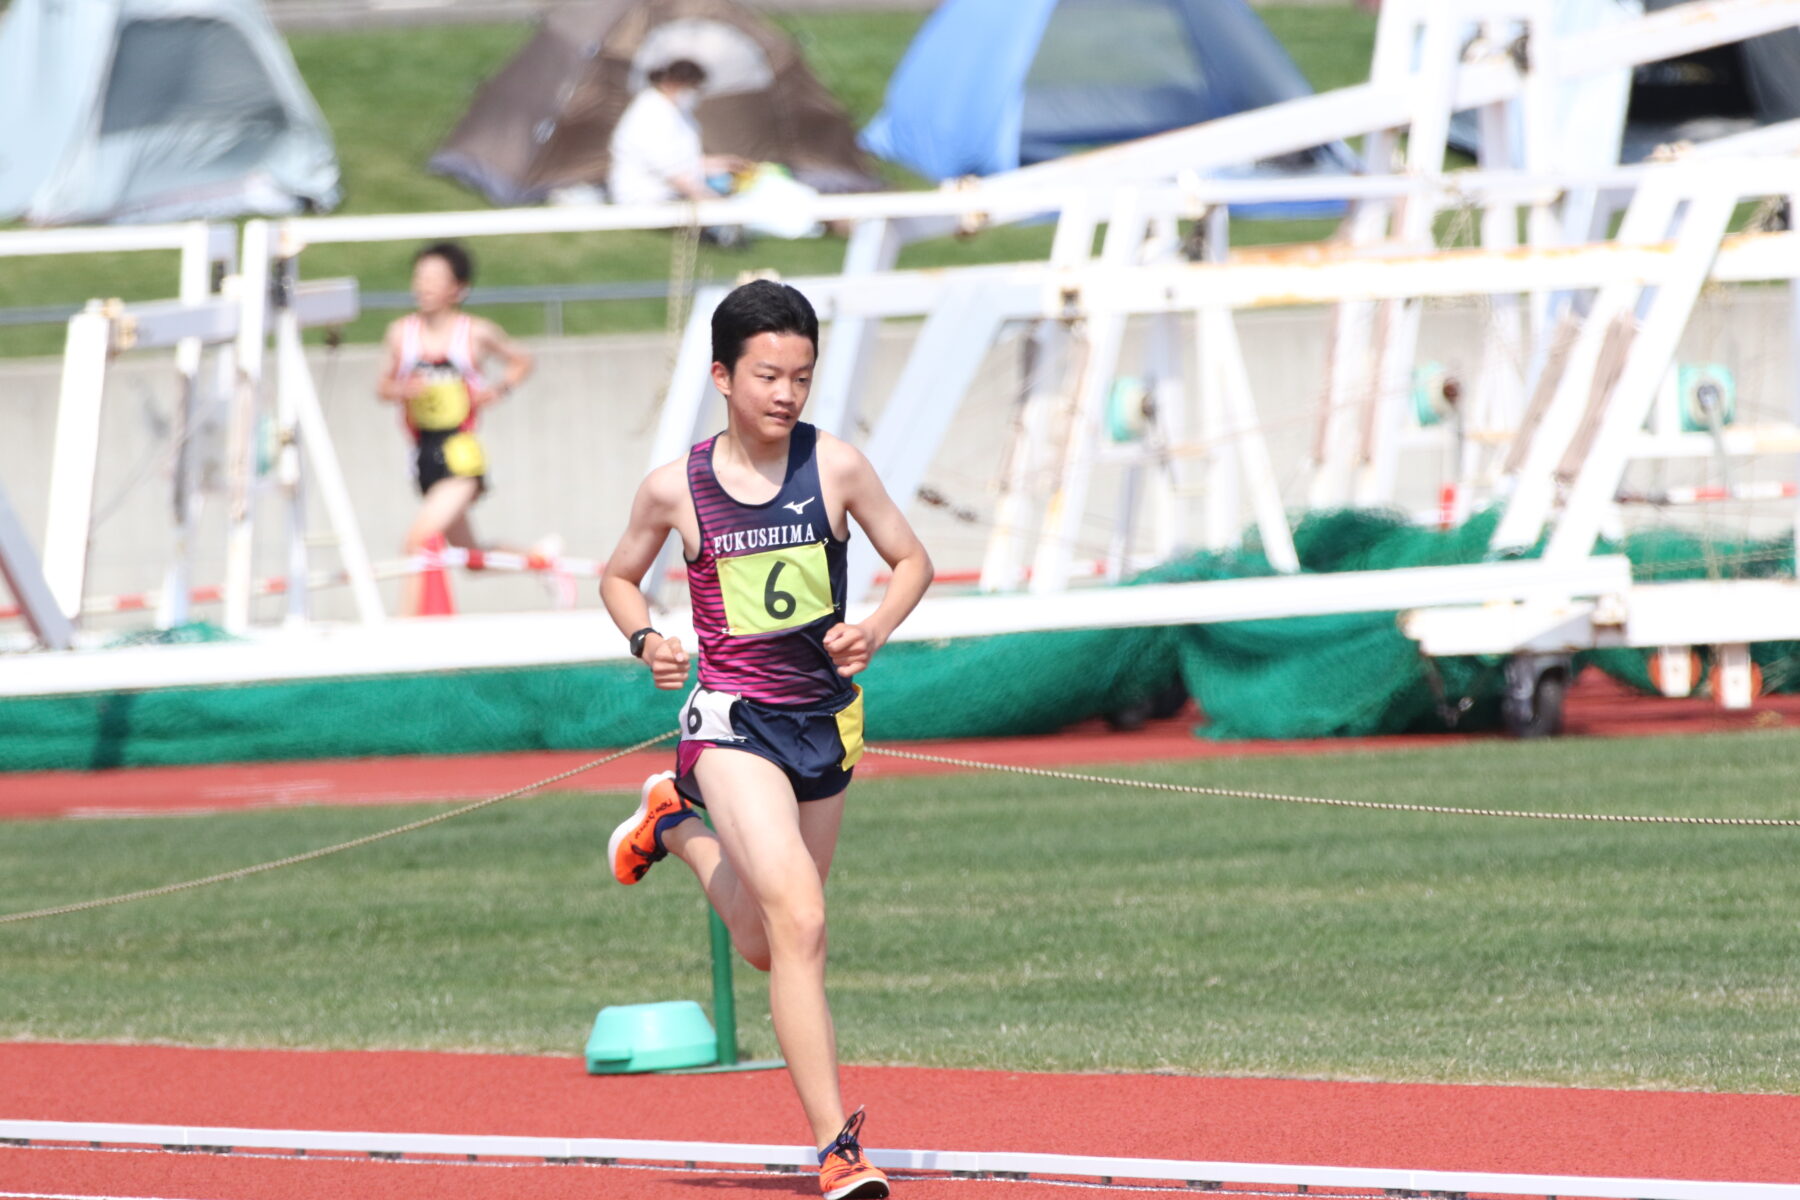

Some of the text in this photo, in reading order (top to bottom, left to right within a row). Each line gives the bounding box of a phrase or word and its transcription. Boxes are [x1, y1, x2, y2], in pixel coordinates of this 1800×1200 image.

[713, 523, 816, 554] FUKUSHIMA
[764, 560, 797, 620] 6
[687, 686, 713, 735] 6
